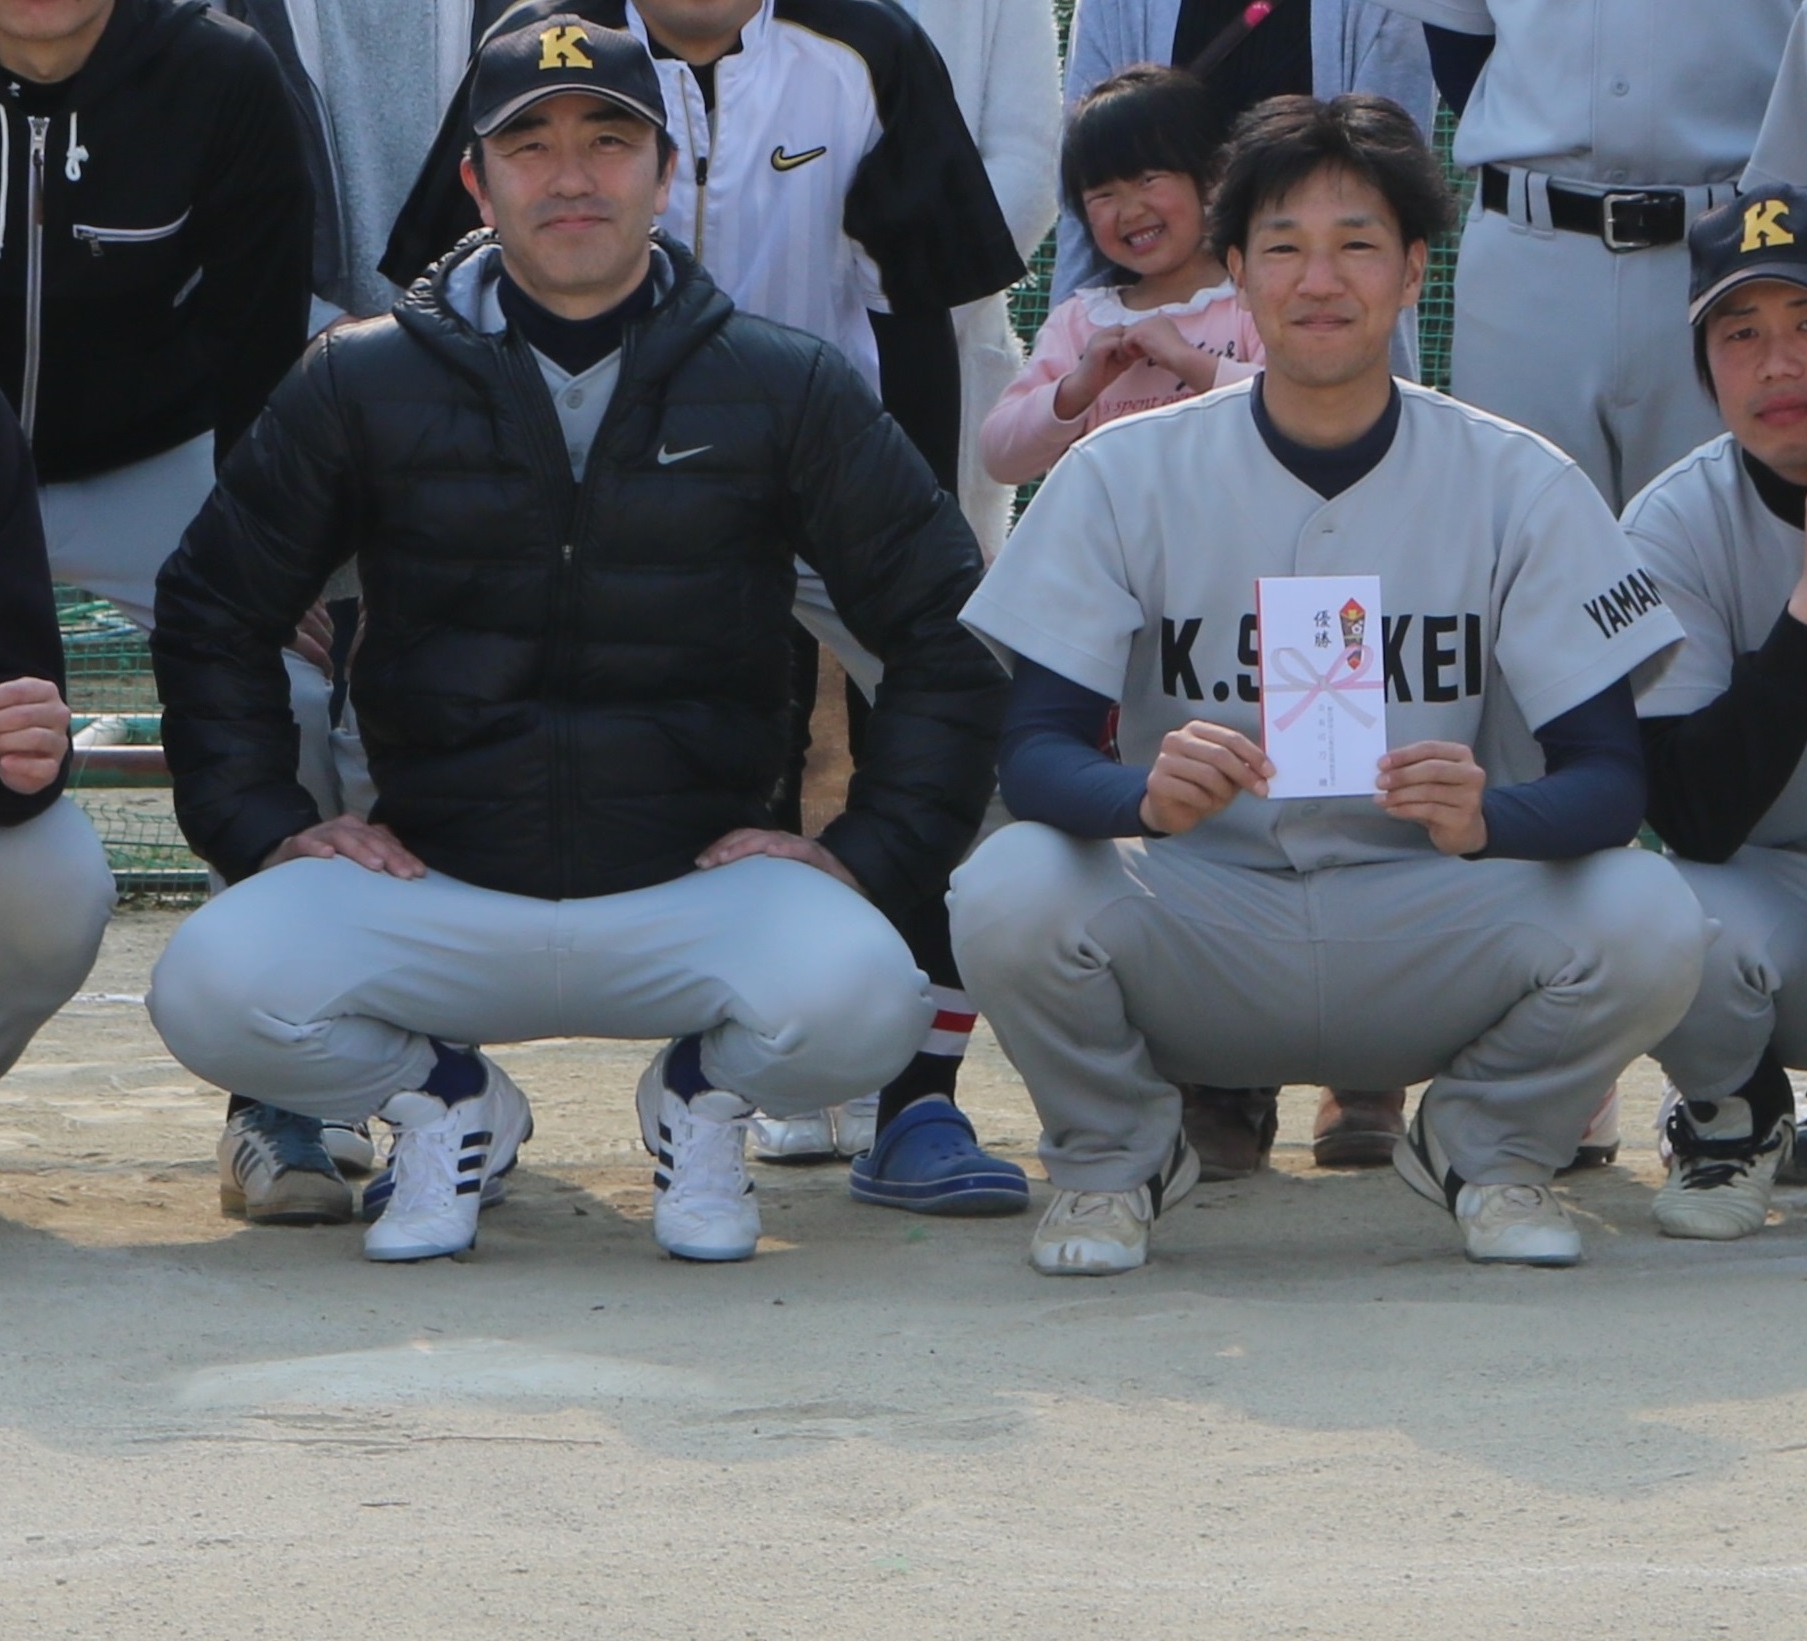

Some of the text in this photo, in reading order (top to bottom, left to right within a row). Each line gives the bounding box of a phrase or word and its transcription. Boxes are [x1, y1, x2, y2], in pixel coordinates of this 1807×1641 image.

[539, 26, 593, 70] K
[1740, 199, 1795, 252] K
[1313, 609, 1332, 648] 優勝
